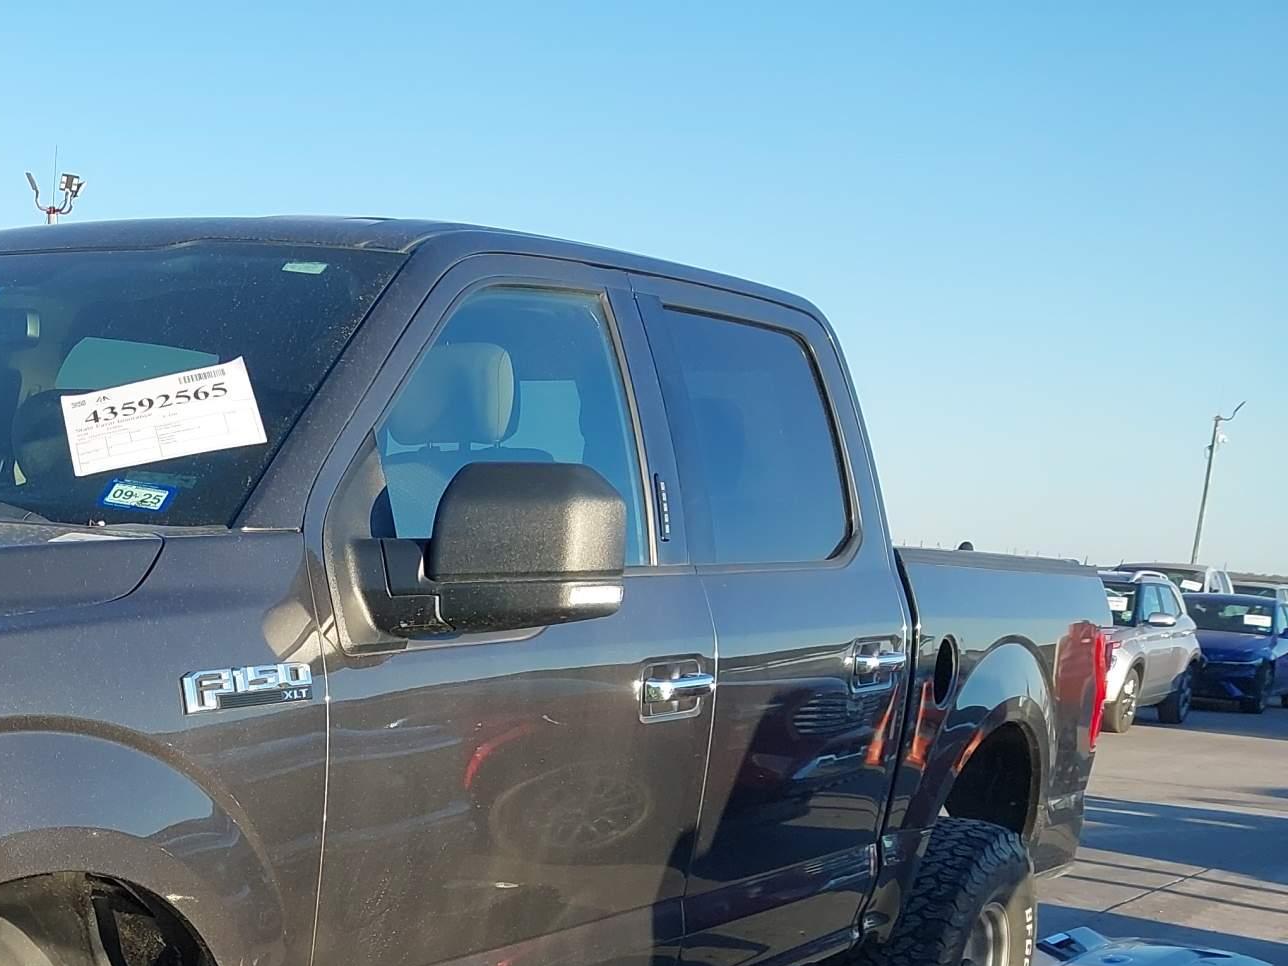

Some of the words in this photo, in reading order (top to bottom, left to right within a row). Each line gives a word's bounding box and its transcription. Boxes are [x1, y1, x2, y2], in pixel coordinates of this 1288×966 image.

[84, 381, 228, 424] 43592565
[112, 488, 134, 500] 09
[139, 492, 164, 505] 25
[283, 688, 309, 700] XLT
